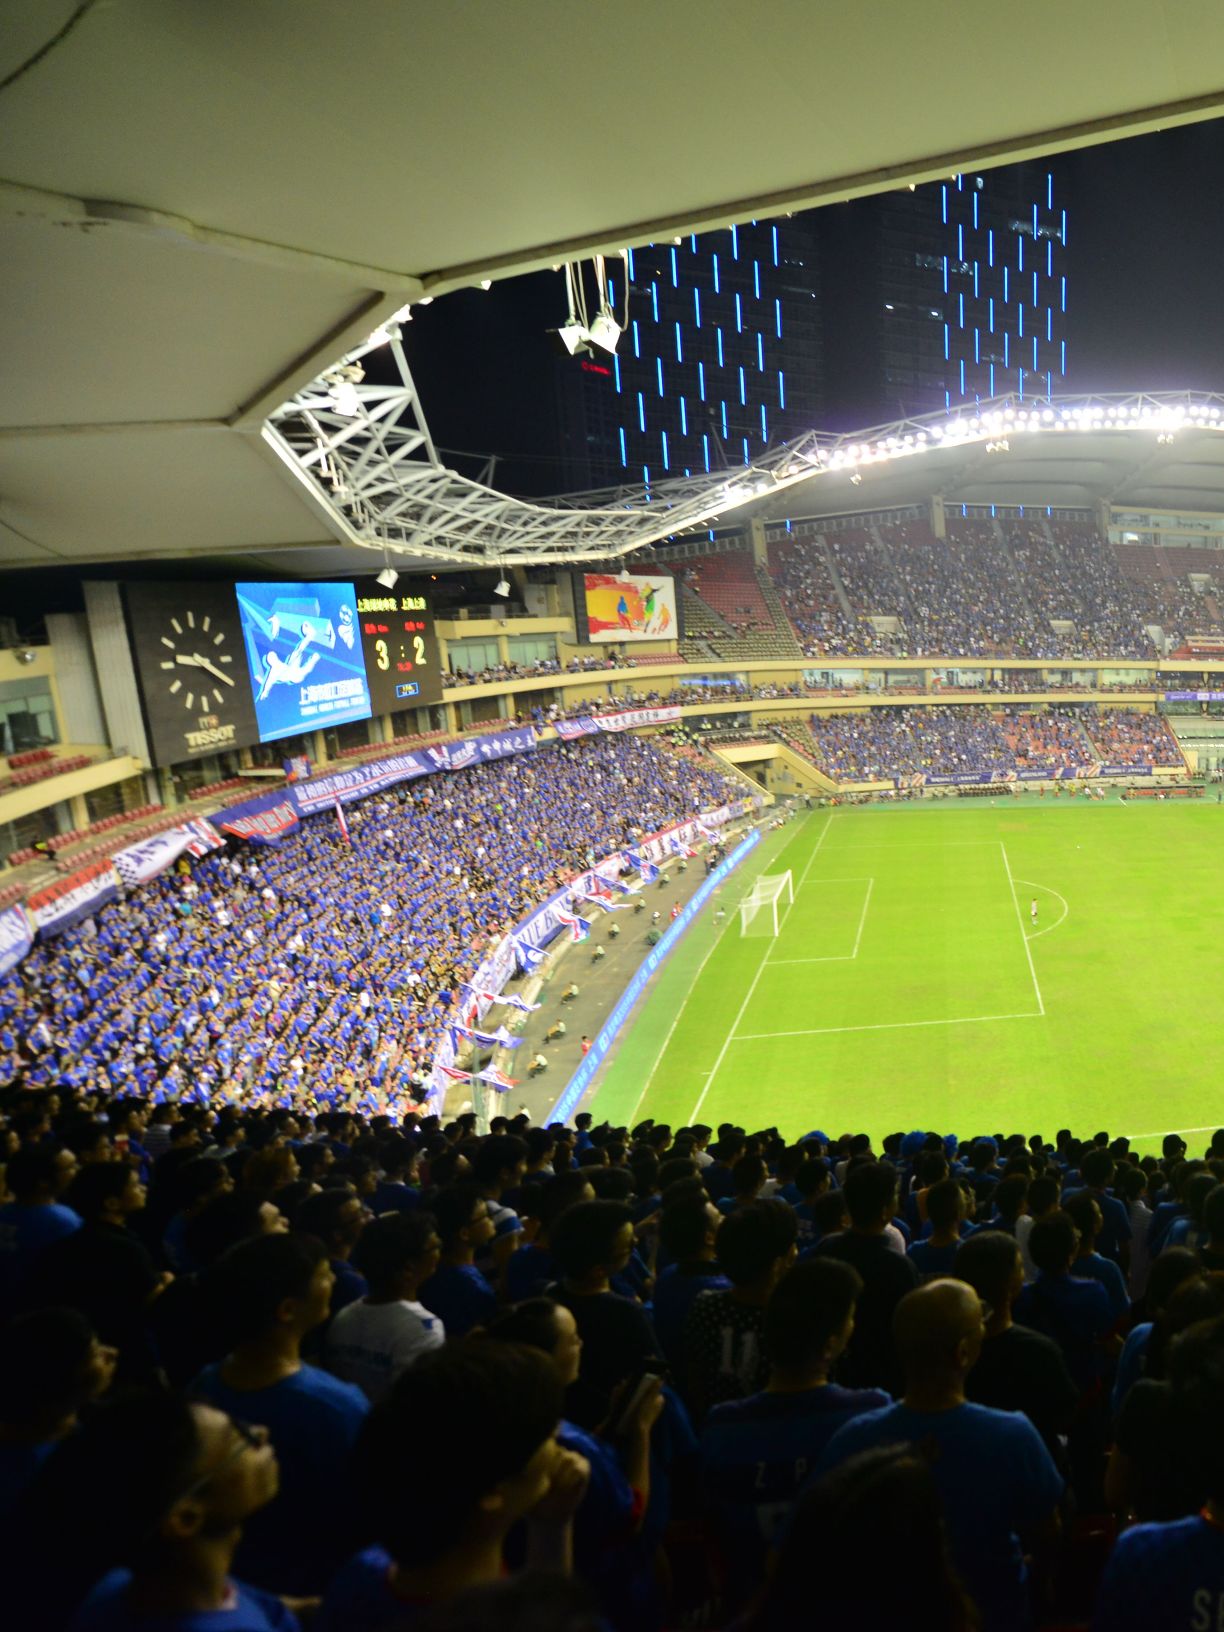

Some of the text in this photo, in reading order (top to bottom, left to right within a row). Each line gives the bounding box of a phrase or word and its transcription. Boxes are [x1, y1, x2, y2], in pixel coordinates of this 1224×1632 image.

[375, 640, 390, 670] 3
[413, 636, 427, 665] 2
[184, 724, 236, 747] TISSOT
